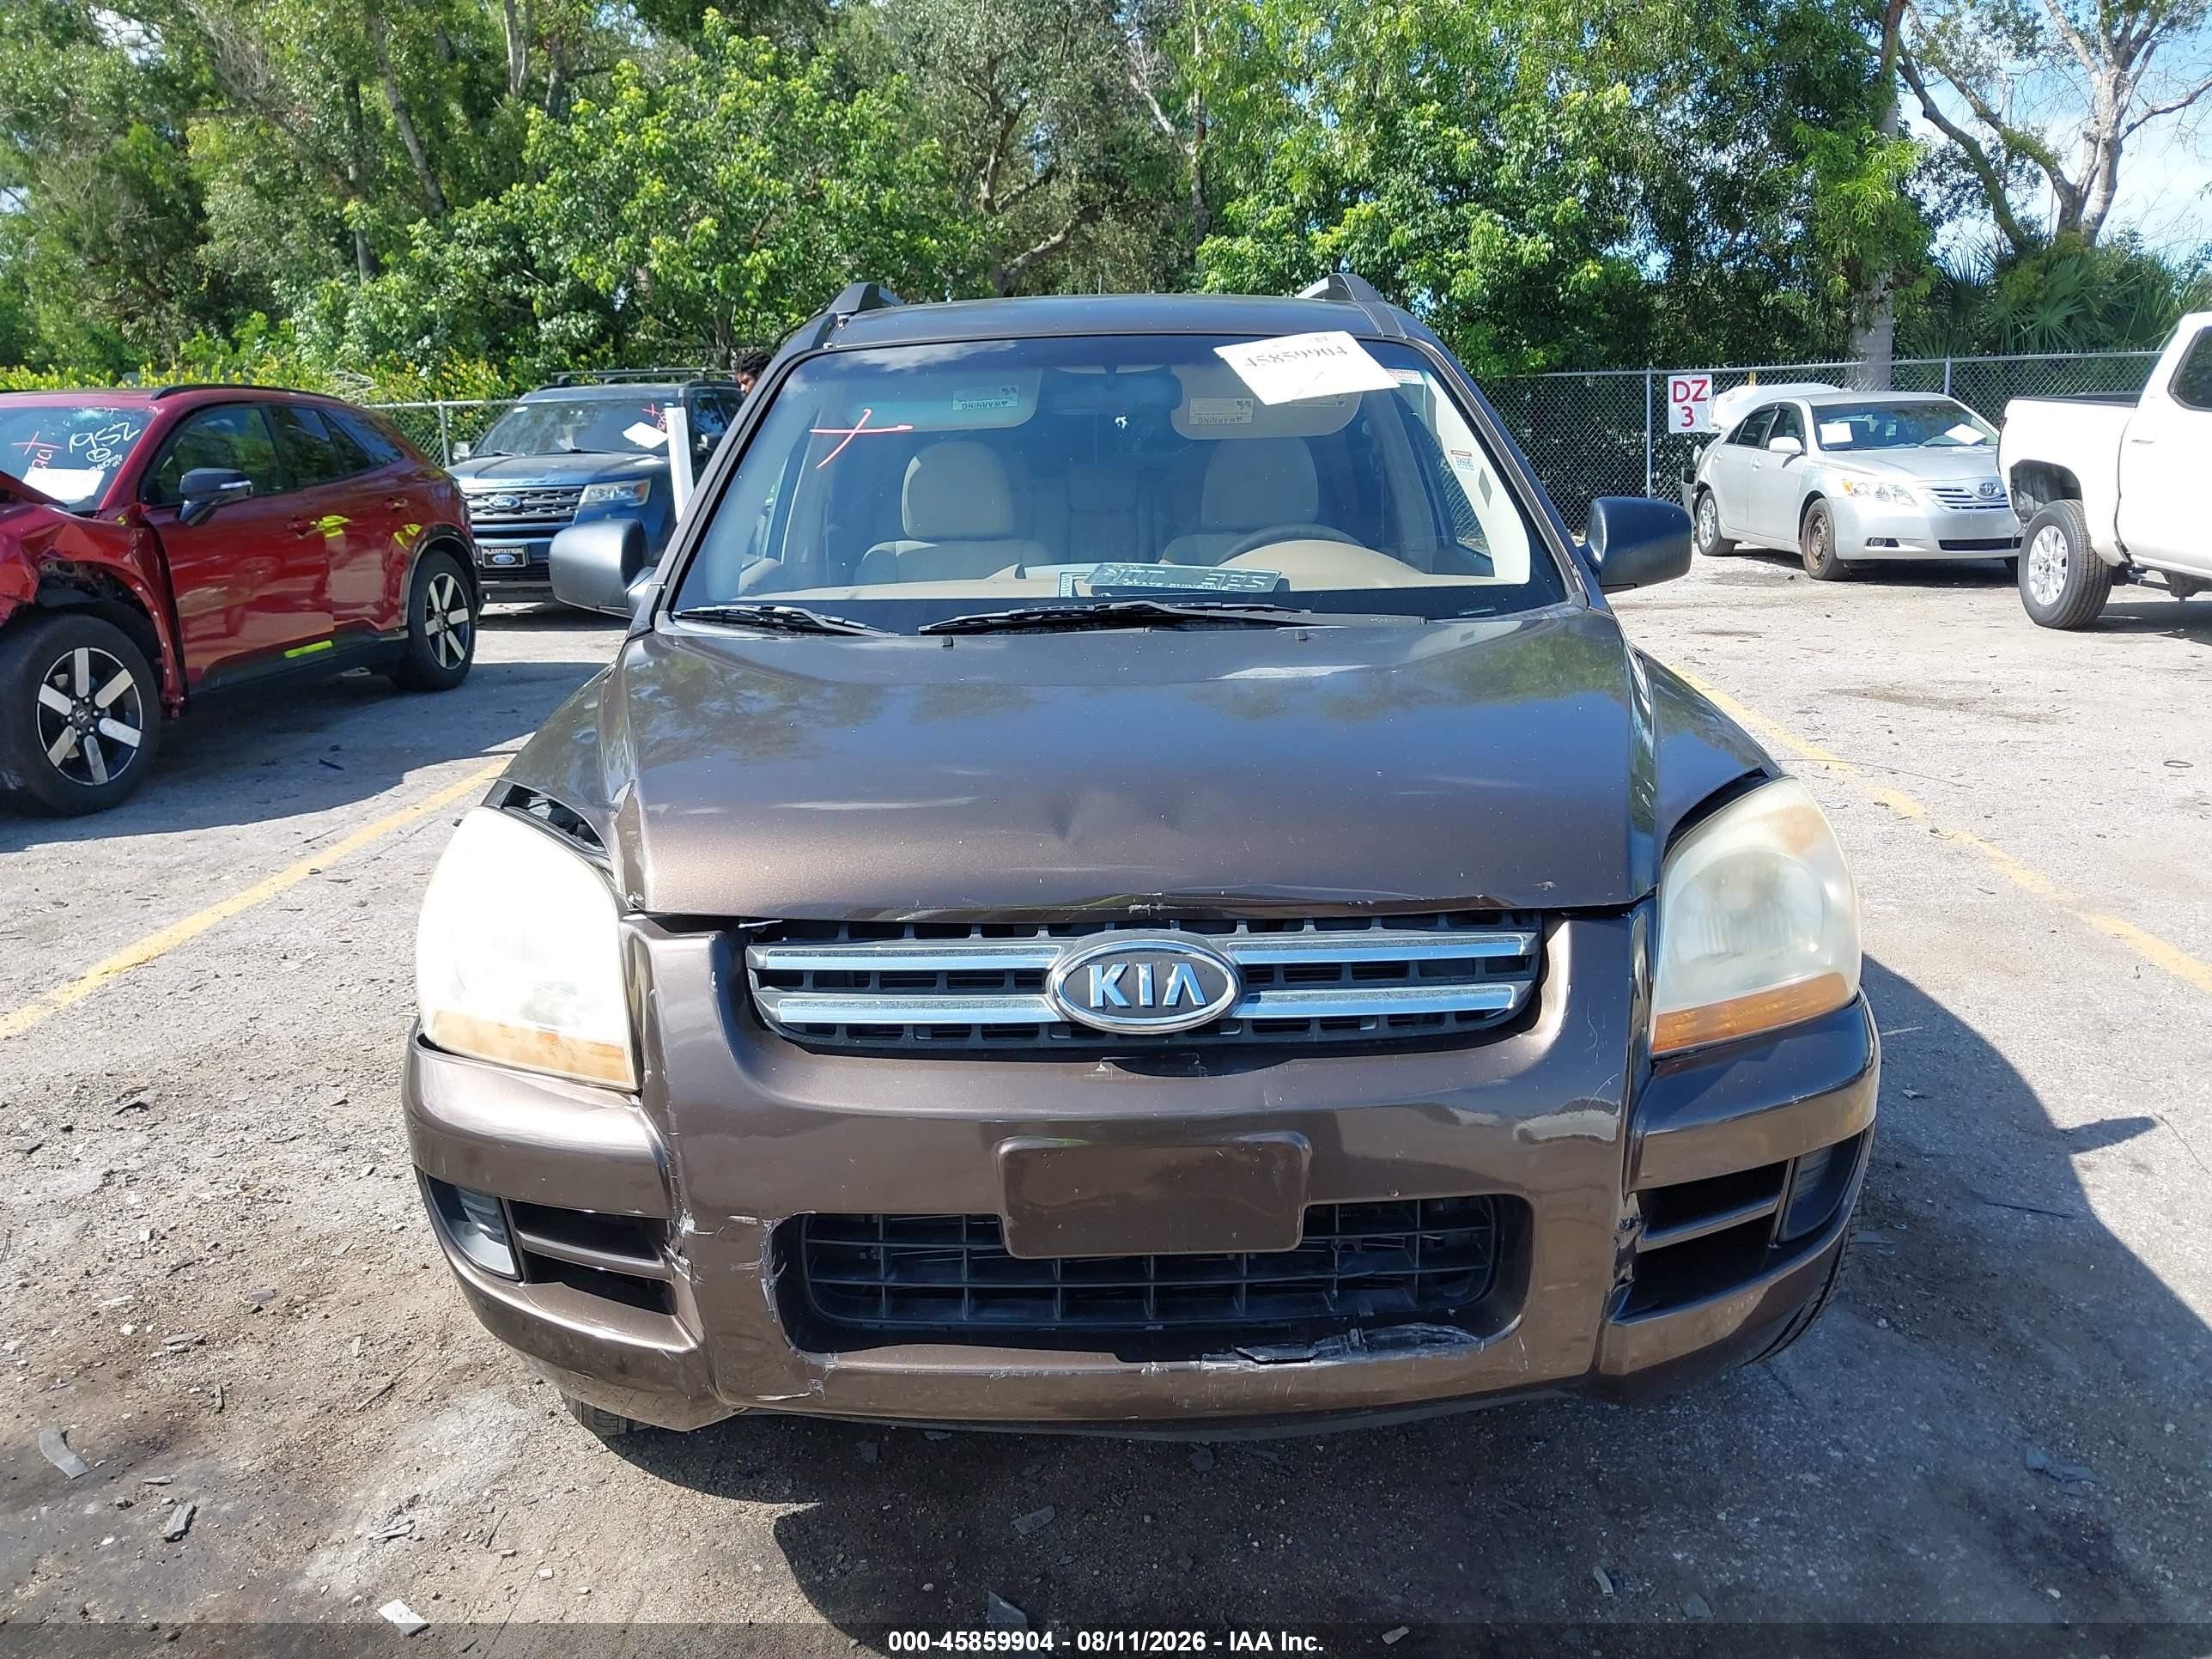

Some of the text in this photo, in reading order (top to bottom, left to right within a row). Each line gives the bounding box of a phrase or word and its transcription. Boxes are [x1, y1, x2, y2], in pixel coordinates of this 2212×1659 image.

[1673, 379, 1709, 403] DZ
[1681, 405, 1694, 427] 3
[1087, 963, 1207, 1008] KIA
